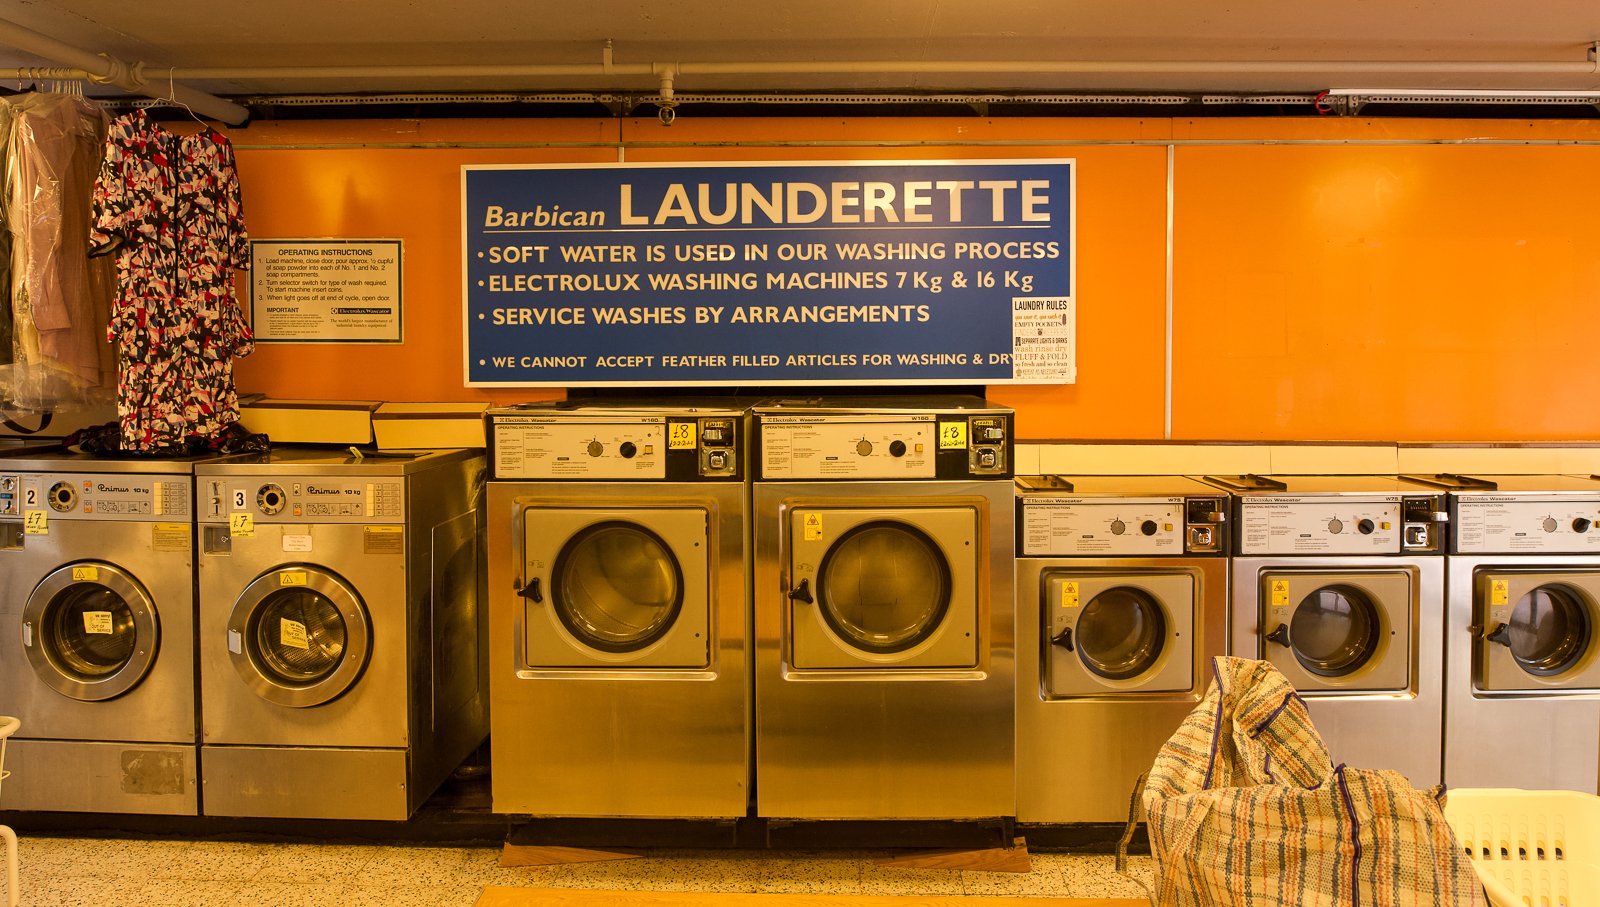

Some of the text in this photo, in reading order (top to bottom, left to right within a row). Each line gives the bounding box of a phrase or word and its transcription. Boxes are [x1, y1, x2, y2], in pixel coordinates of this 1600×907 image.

[485, 181, 1050, 226] Barbican LAUNDERETTE
[490, 242, 1059, 263] SOFT WATER IS USED IN OUR WASHING PROCESS
[490, 271, 1033, 293] ELECTROLUX WASHING MACHINES 7 Kg & 16 Kg
[1014, 300, 1068, 311] LAUNDRY RULES
[493, 305, 929, 324] SERVICE WASHES BY ARRANGEMENTS
[493, 357, 515, 367] WE
[521, 357, 586, 367] CANNOT
[596, 356, 654, 367] ACCEPT
[663, 356, 726, 366] FEATHER
[733, 356, 779, 366] FILLED
[786, 355, 856, 365] ARTICLES
[863, 355, 891, 365] FOR
[897, 354, 966, 365] WASHING
[973, 354, 983, 364] &
[673, 424, 689, 439] £8
[943, 426, 959, 439] £8
[27, 489, 36, 505] 2
[235, 492, 245, 507] 3
[28, 512, 42, 525] £7
[233, 515, 248, 528] £7
